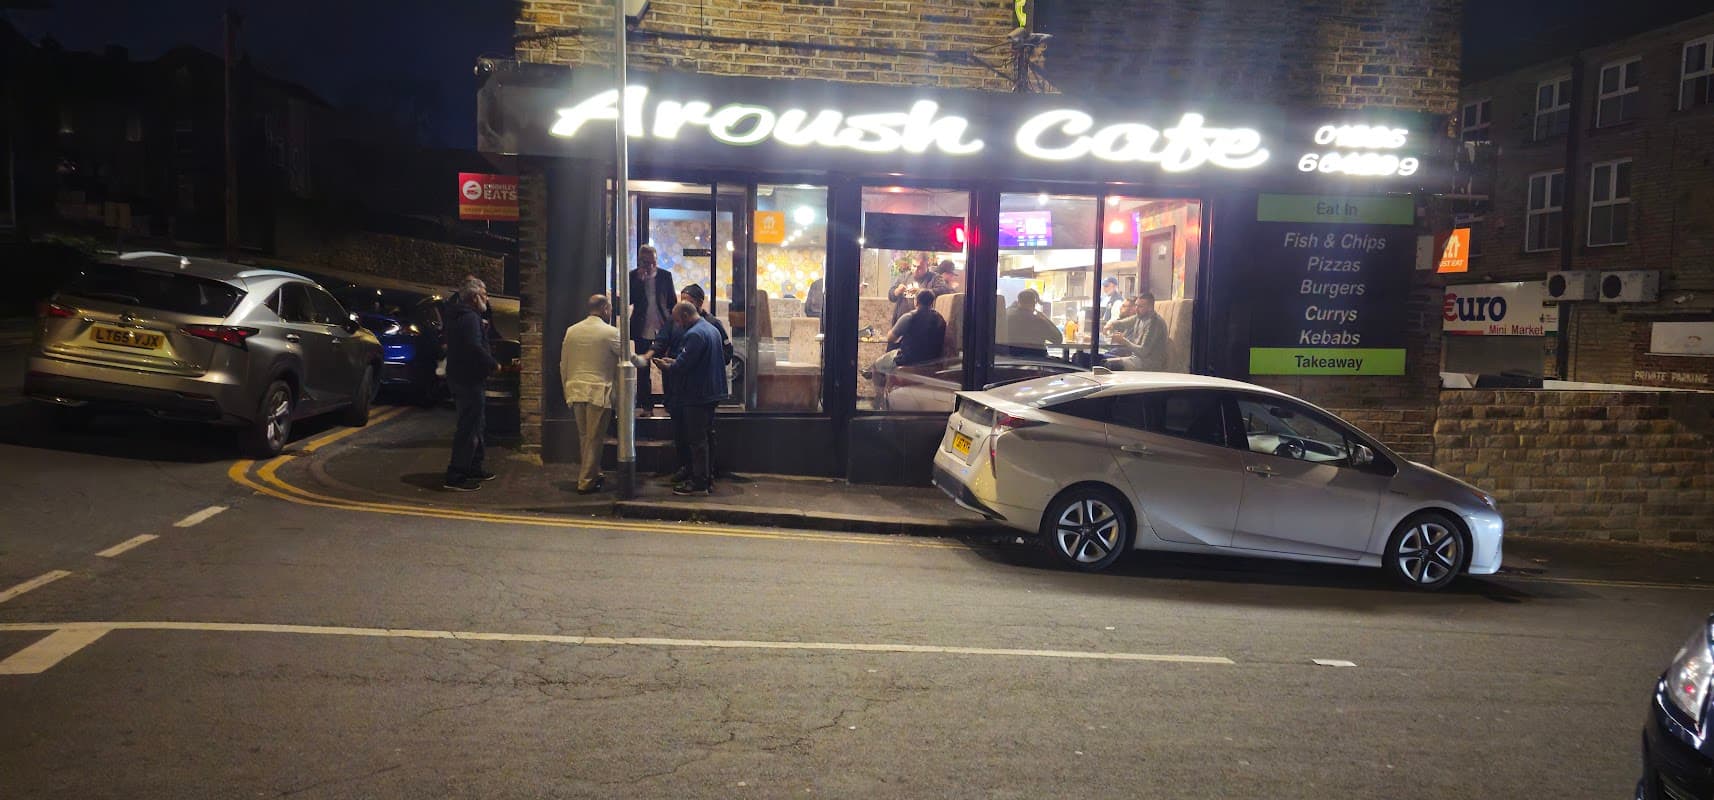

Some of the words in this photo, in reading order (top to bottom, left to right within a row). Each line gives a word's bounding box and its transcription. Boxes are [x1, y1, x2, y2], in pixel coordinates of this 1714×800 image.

[549, 85, 985, 156] Aroush
[1015, 108, 1270, 173] Cafe
[484, 190, 518, 201] EATS
[1316, 202, 1339, 216] Eat
[1345, 203, 1358, 216] In
[1284, 232, 1318, 249] Fish
[1324, 233, 1335, 249] &
[1341, 233, 1387, 252] Chips
[1307, 256, 1361, 272] Pizzas
[1301, 279, 1365, 298] Burgers
[1305, 305, 1358, 325] Currys
[1443, 293, 1507, 322] €uro
[96, 329, 129, 343] LT65
[134, 335, 159, 347] VJX
[1300, 329, 1361, 345] Kebabs
[1488, 325, 1507, 335] Mini
[1511, 325, 1544, 336] Market
[1294, 355, 1363, 371] Takeaway
[1634, 370, 1667, 381] PRIVATE
[1671, 372, 1709, 384] PARKING
